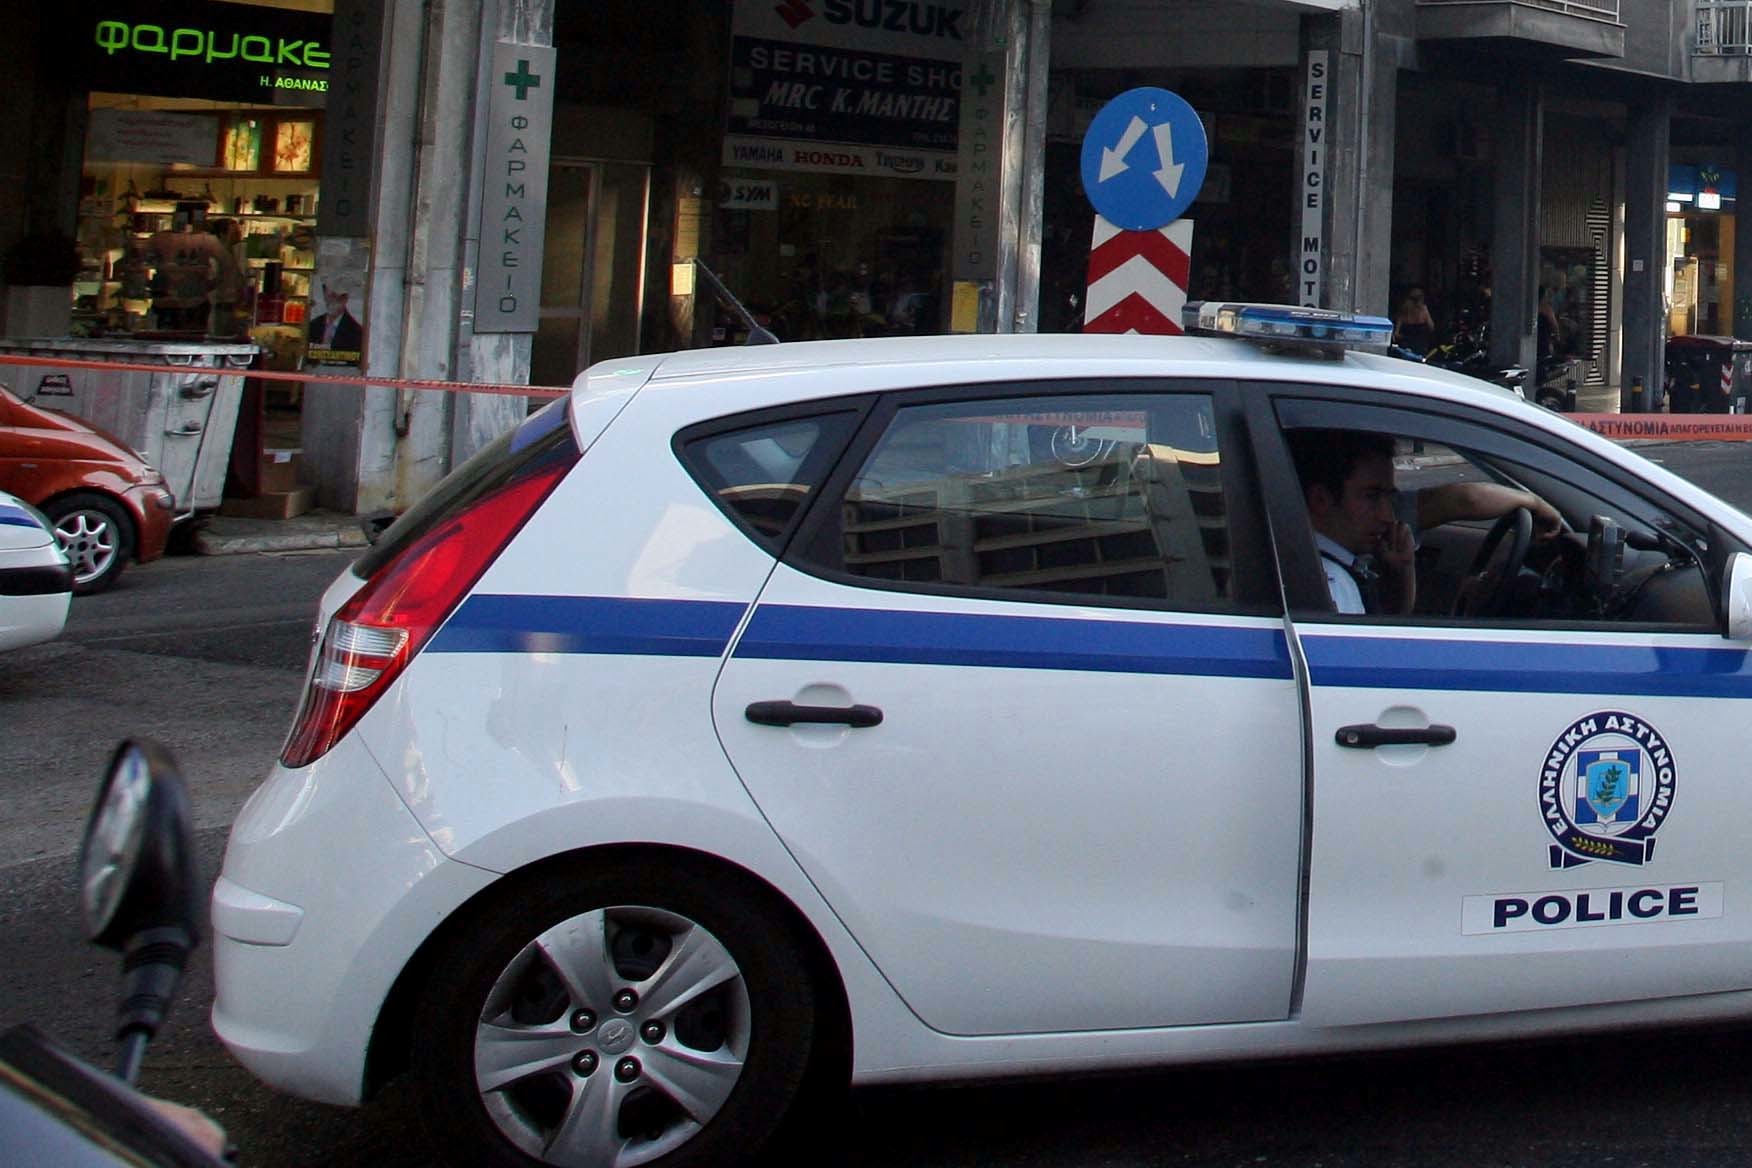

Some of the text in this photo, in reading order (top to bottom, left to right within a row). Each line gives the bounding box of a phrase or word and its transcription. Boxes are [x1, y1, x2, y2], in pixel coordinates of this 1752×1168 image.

[94, 19, 331, 69] φαρμακε
[749, 46, 962, 91] SERVICE SHO
[274, 76, 329, 92] ΑΘΑΝΑΣ
[335, 12, 367, 217] ΦΑΡΜΑΚΕΙΟ
[732, 144, 785, 164] YAMAHA
[792, 149, 864, 168] HONDA
[734, 182, 771, 203] SYM
[968, 108, 990, 265] ΦΑΡΜΑΚΕΙΟ
[1303, 62, 1324, 309] SERVICE MOT
[498, 115, 529, 313] ΦΑΡΜΑΚΕΙΟ
[1543, 715, 1673, 836] ΕΛΛΗΝΙΚΗ ΑΣΤΥΝΟΜΙΑ
[1493, 887, 1699, 928] POLICE
